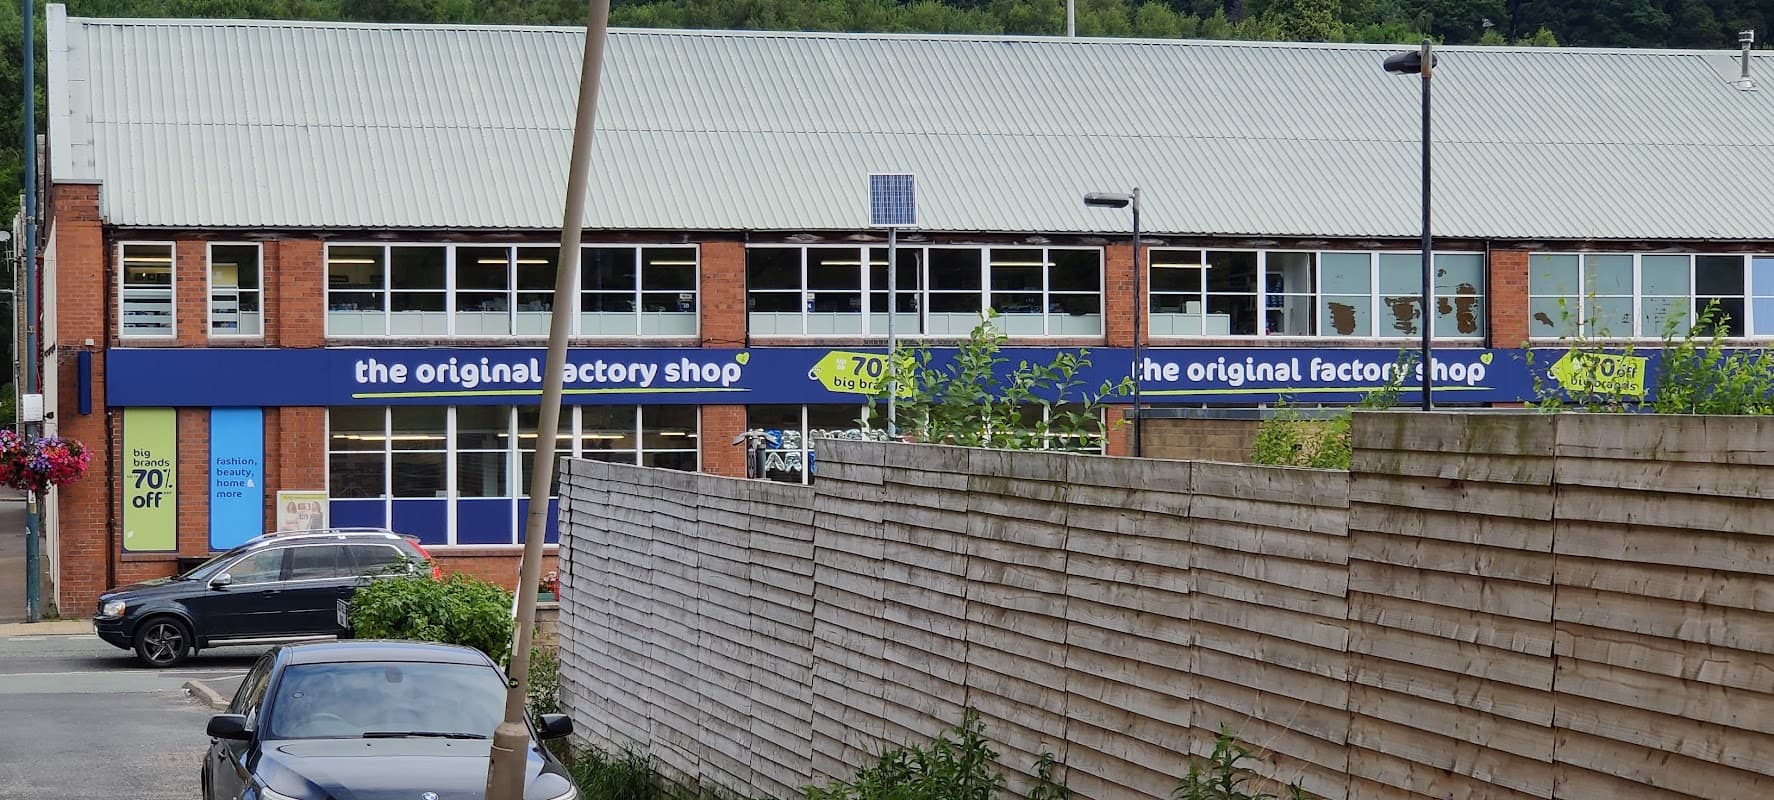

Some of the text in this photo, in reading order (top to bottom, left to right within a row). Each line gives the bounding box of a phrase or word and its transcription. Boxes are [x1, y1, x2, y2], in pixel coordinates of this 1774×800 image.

[355, 357, 741, 388] the original actory shop
[852, 356, 889, 378] 70
[1187, 357, 1301, 386] original
[1311, 357, 1408, 386] factory
[834, 376, 855, 389] big
[134, 448, 151, 458] big
[134, 459, 170, 467] brands
[216, 457, 257, 466] fashion,
[131, 468, 173, 490] 70%
[216, 468, 255, 478] beauty,
[216, 479, 246, 487] home
[132, 491, 163, 508] off
